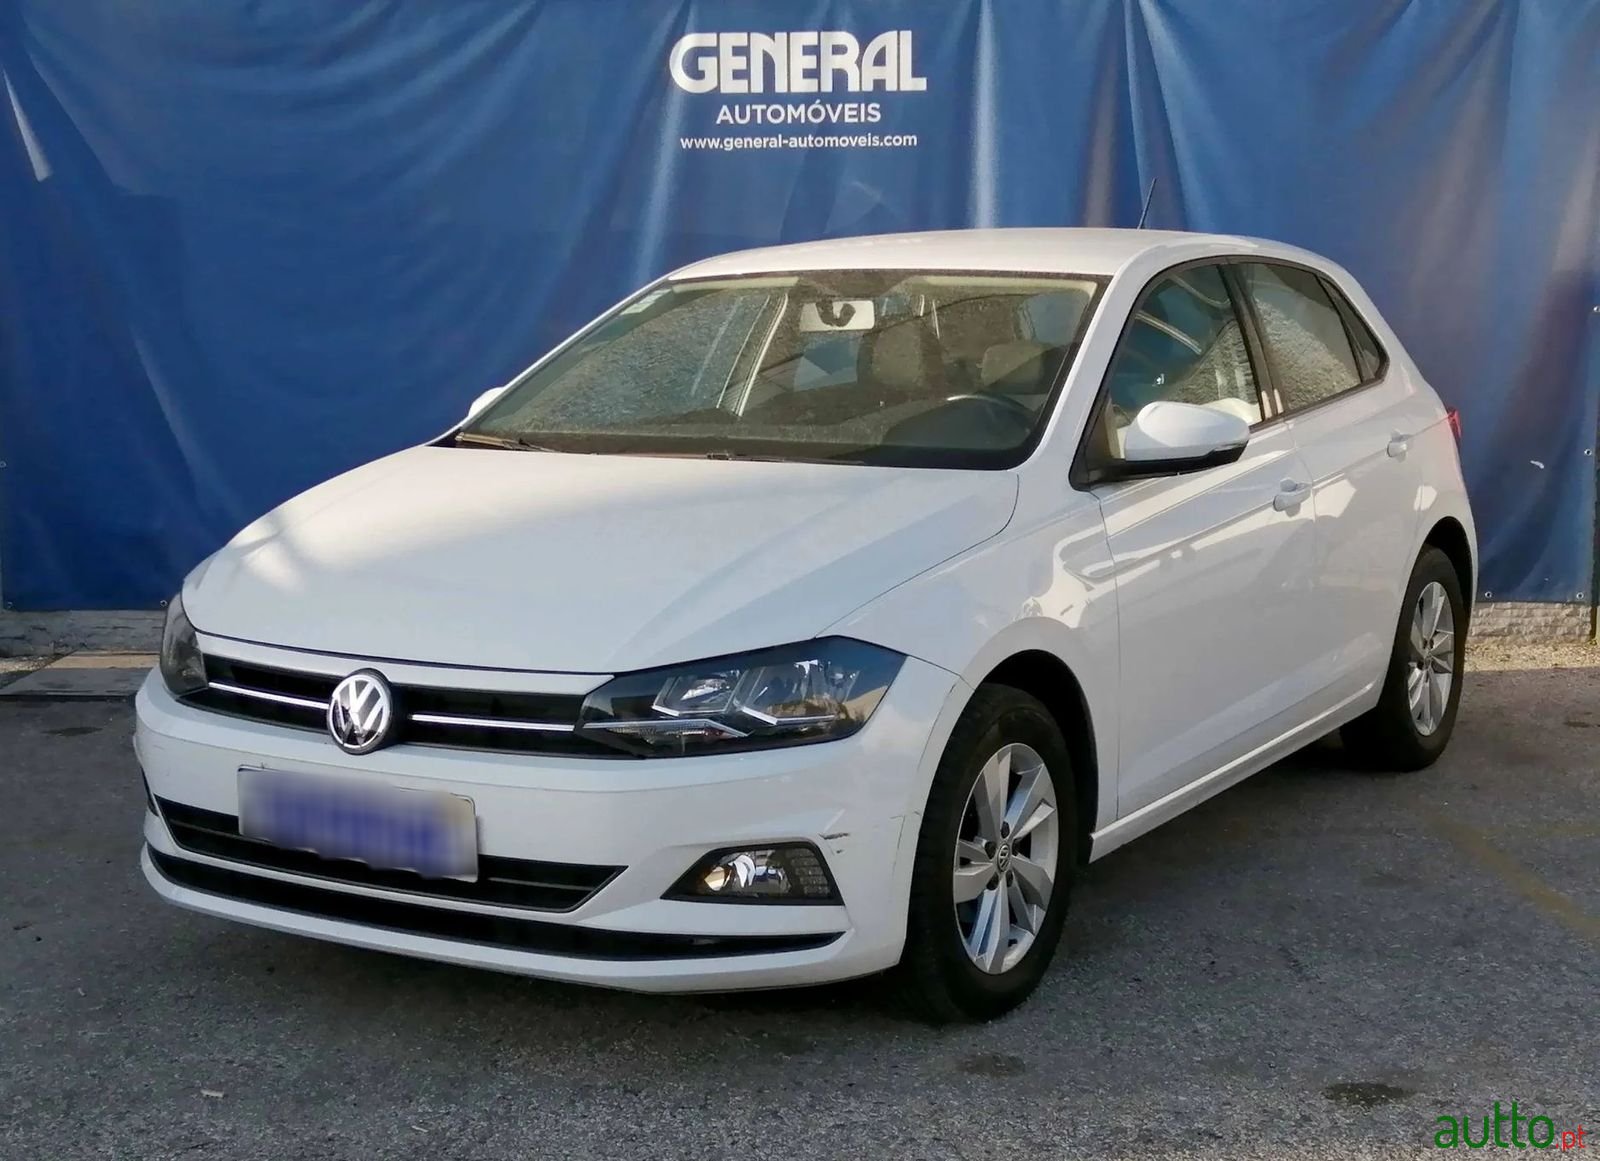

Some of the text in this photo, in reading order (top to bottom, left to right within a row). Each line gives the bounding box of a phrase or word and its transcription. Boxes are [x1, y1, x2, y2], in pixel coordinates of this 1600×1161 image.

[669, 30, 927, 94] GENERAL
[716, 99, 881, 124] AUTOMÓVEIS
[680, 133, 918, 151] www.general-automoveis.com
